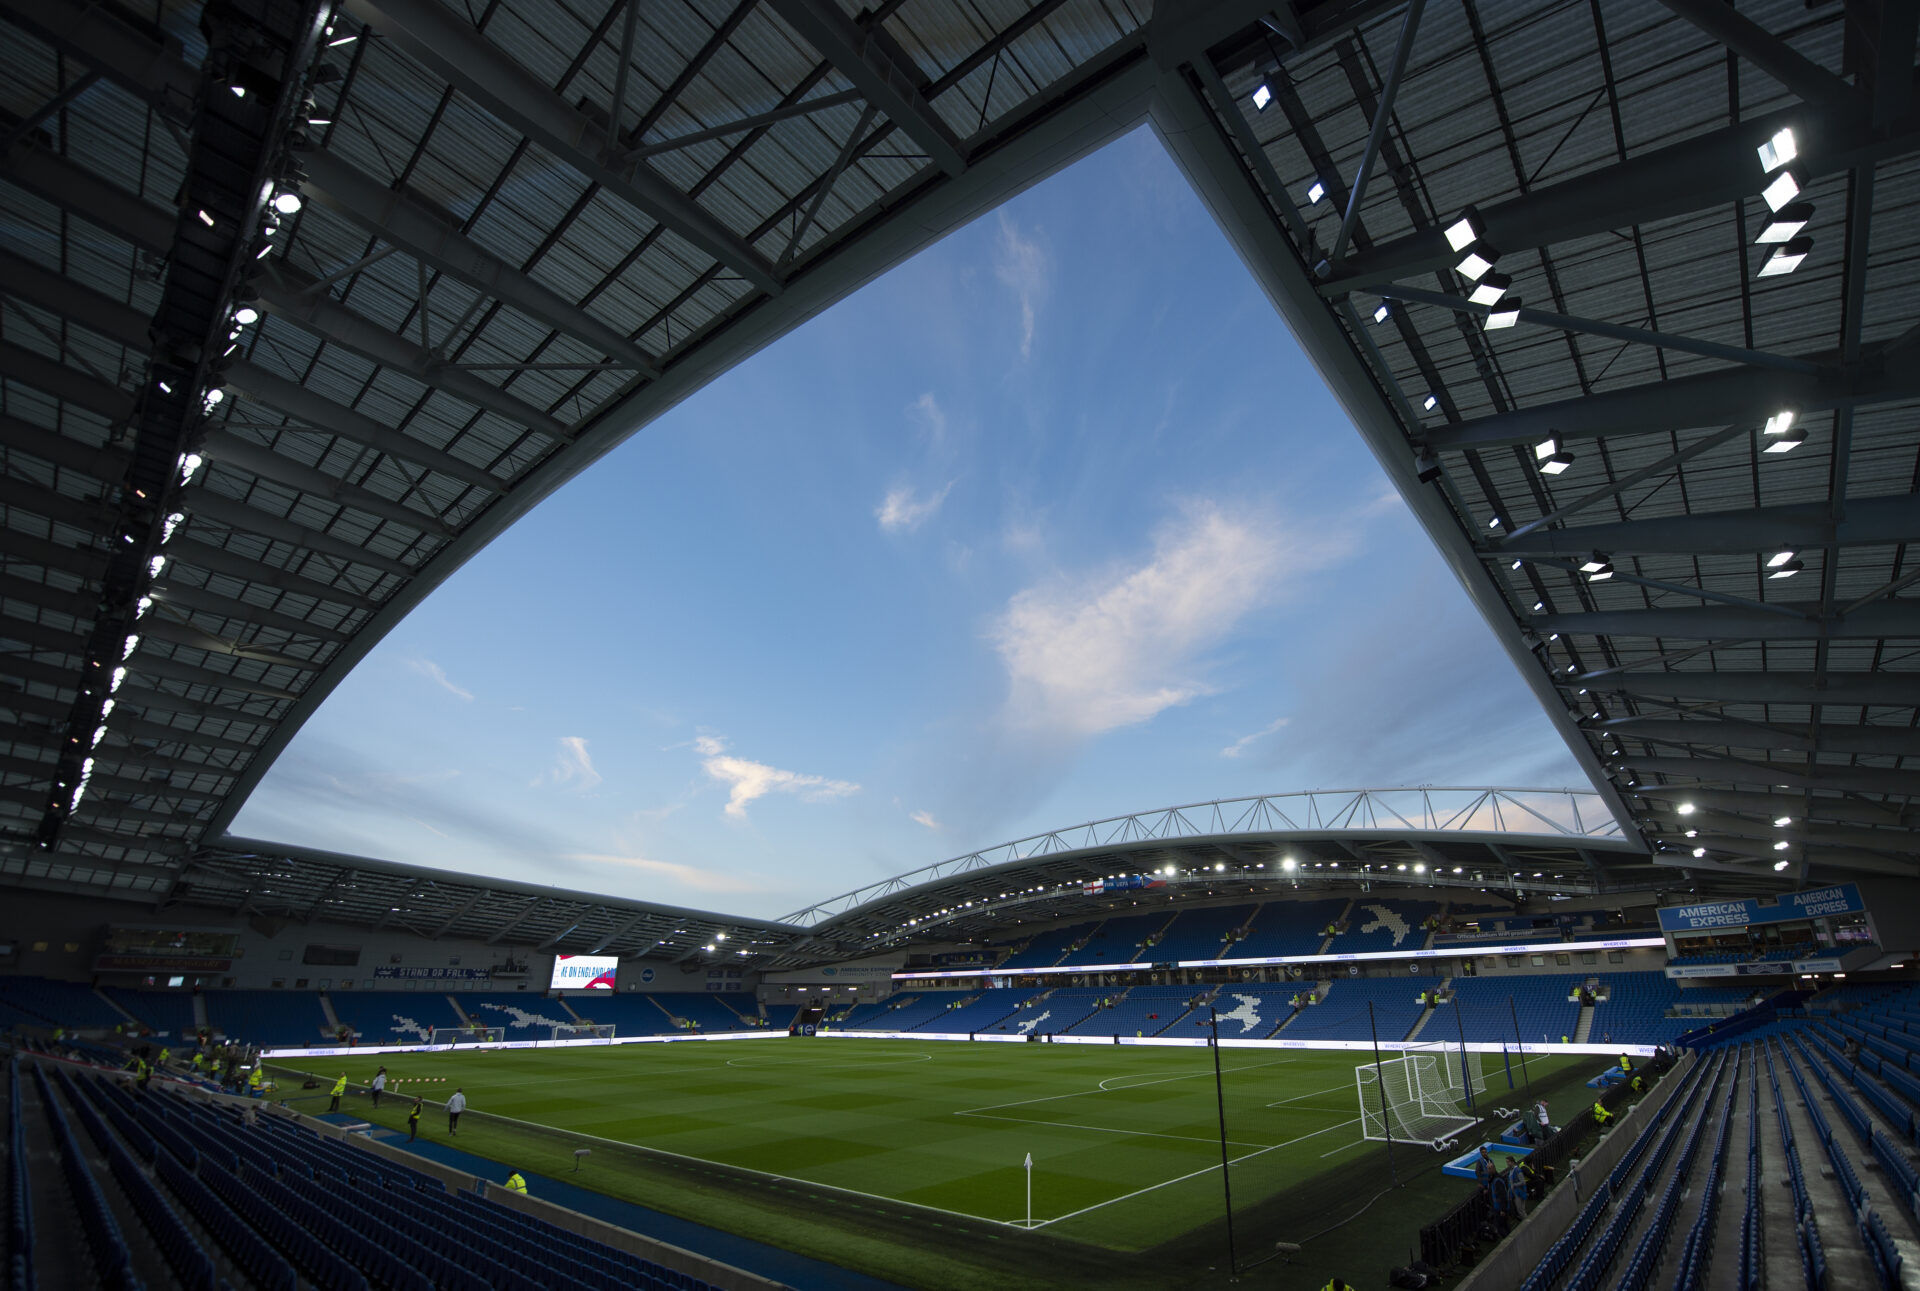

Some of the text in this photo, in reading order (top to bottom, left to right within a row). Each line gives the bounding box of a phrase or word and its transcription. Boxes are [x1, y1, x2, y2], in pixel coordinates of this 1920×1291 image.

[1793, 888, 1844, 906] AMERICAN
[1678, 902, 1746, 919] AMERICAN
[1805, 899, 1849, 916] EXPRESS
[1690, 913, 1750, 928] EXPRESS
[399, 968, 468, 977] STAND OR FALL
